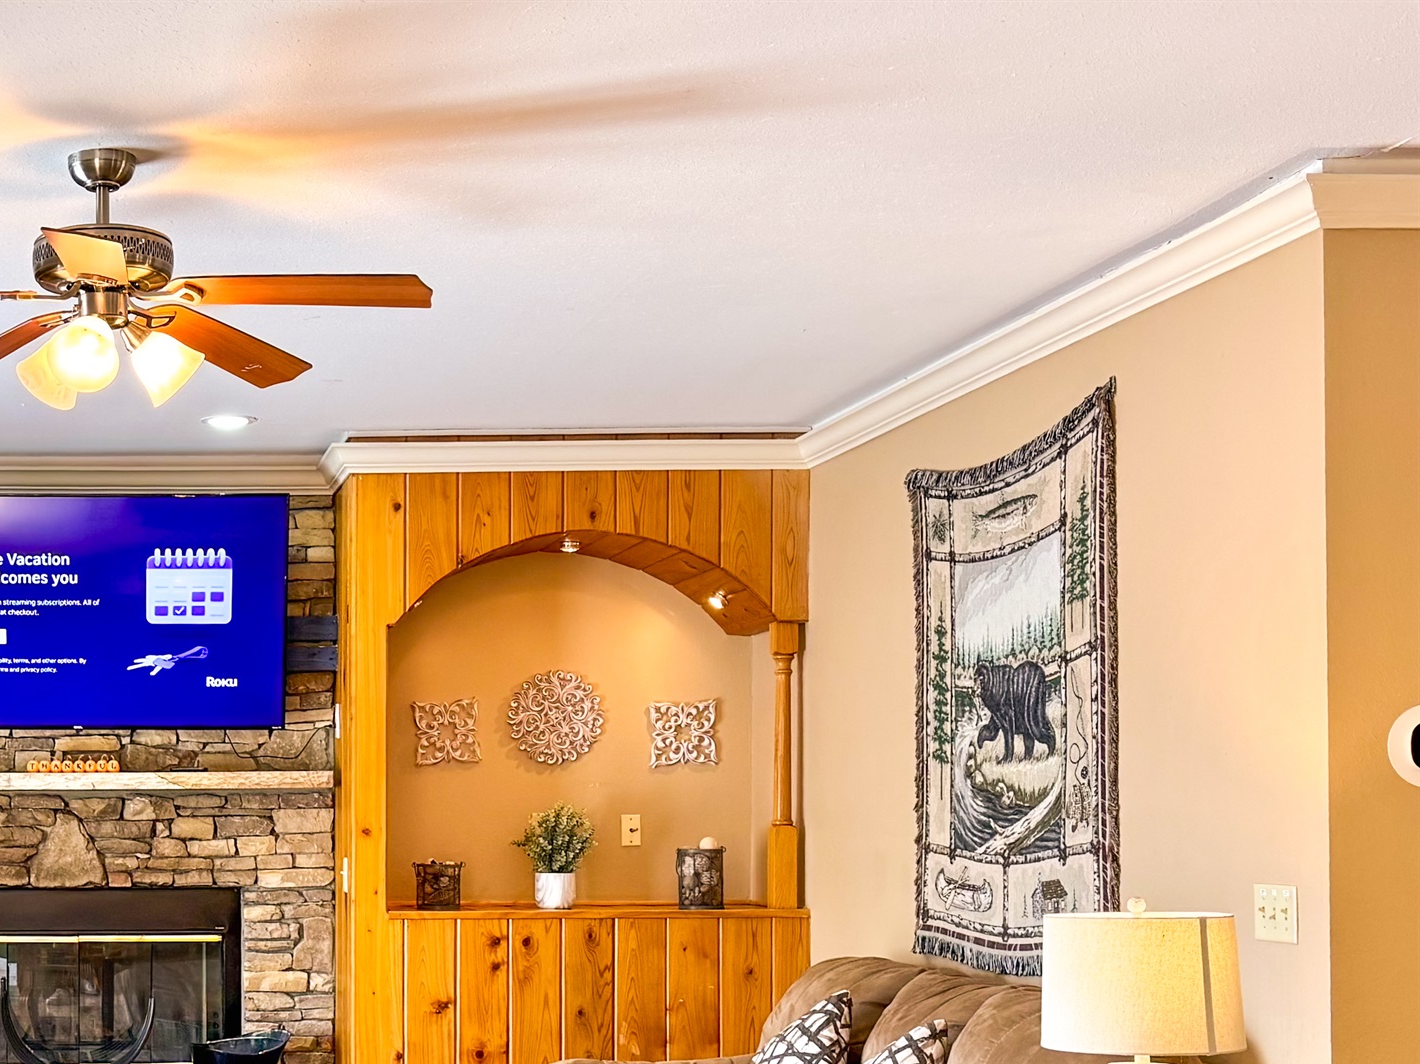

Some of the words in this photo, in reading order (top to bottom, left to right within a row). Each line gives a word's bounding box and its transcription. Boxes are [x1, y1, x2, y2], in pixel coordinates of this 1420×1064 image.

[6, 552, 70, 566] Vacation
[51, 573, 78, 587] you
[2, 598, 36, 607] streaming
[37, 598, 82, 607] subscriptions.
[82, 598, 92, 606] All
[92, 598, 100, 606] of
[7, 608, 40, 616] checkout.
[79, 657, 87, 665] By
[20, 666, 40, 674] privacy
[40, 666, 58, 674] policy.
